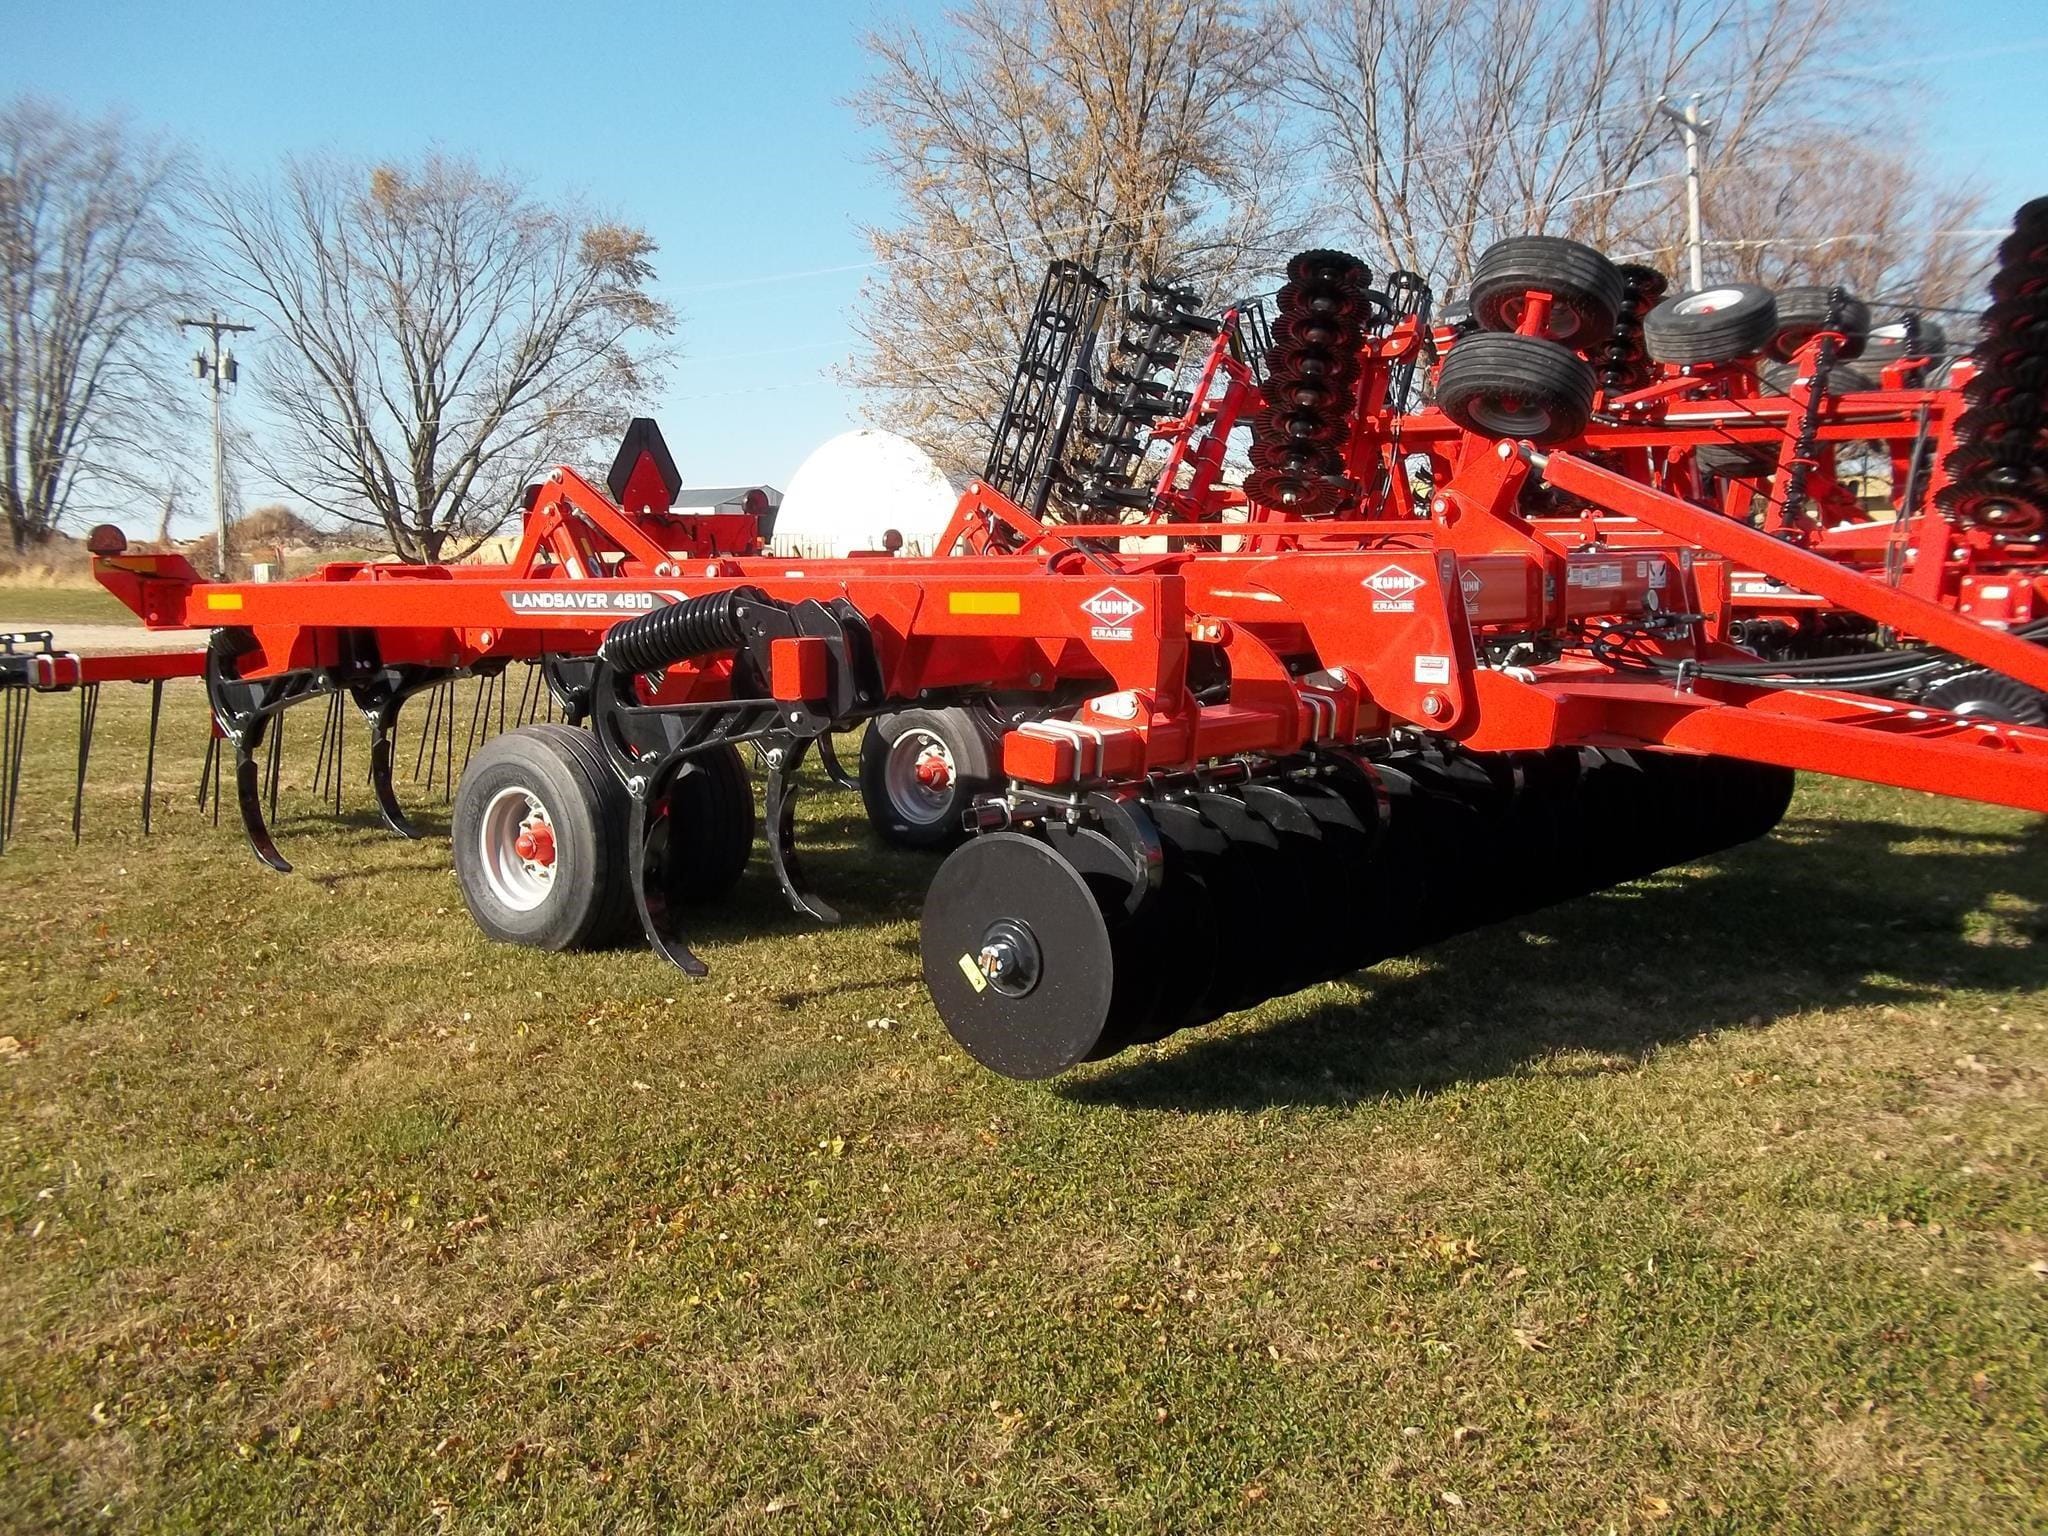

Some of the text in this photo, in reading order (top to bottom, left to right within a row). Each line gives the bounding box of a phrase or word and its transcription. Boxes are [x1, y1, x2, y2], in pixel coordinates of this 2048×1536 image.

[1372, 576, 1415, 589] KUHN
[512, 593, 653, 609] LANDSAVER 4810
[1091, 600, 1133, 614] KUHN
